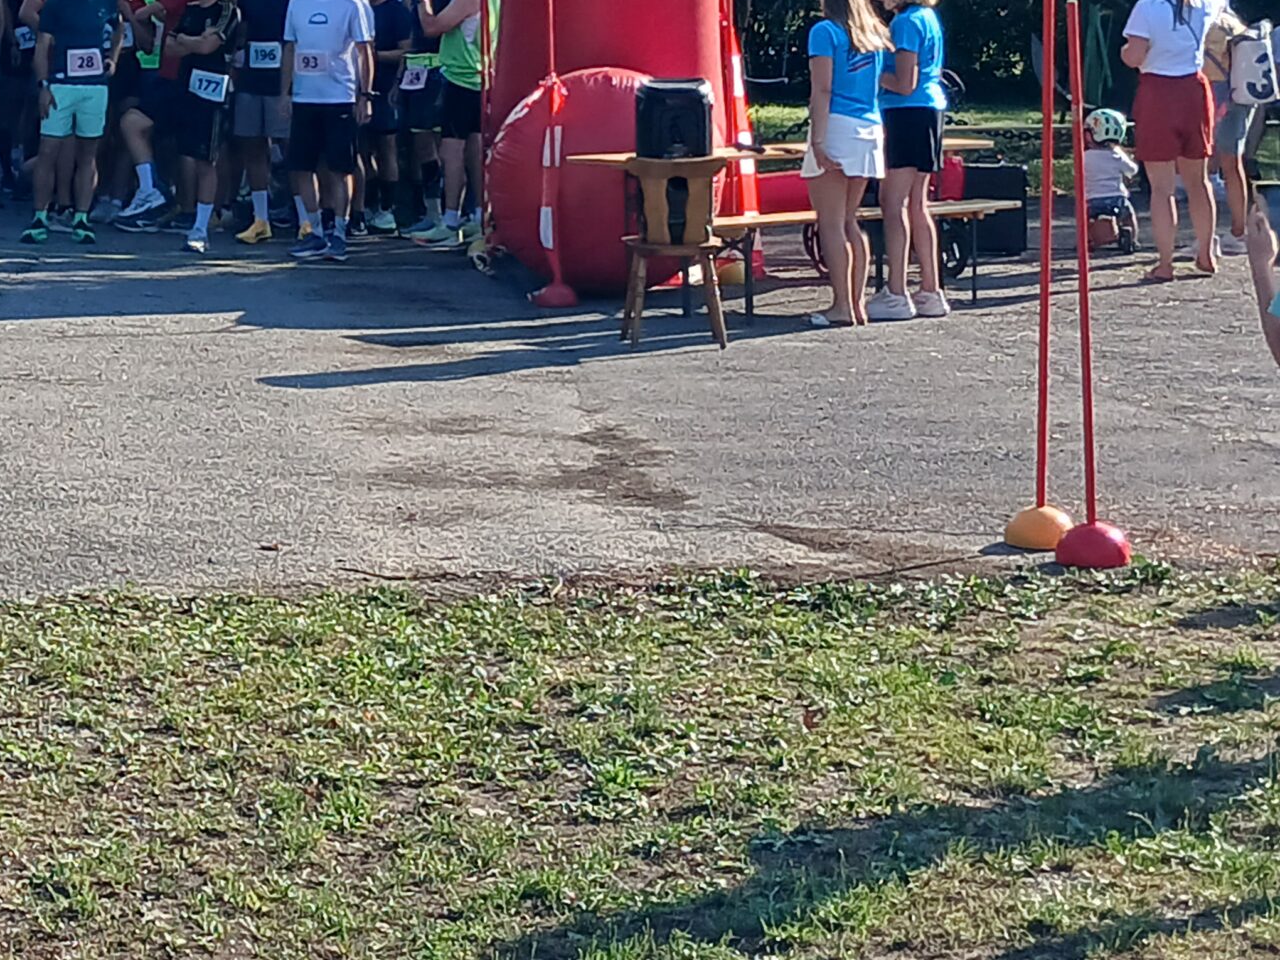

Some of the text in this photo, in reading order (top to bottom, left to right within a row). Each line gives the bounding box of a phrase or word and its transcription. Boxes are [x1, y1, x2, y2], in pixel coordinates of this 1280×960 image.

[254, 49, 277, 61] 196
[78, 55, 95, 69] 28
[302, 56, 319, 69] 93
[197, 78, 221, 93] 177
